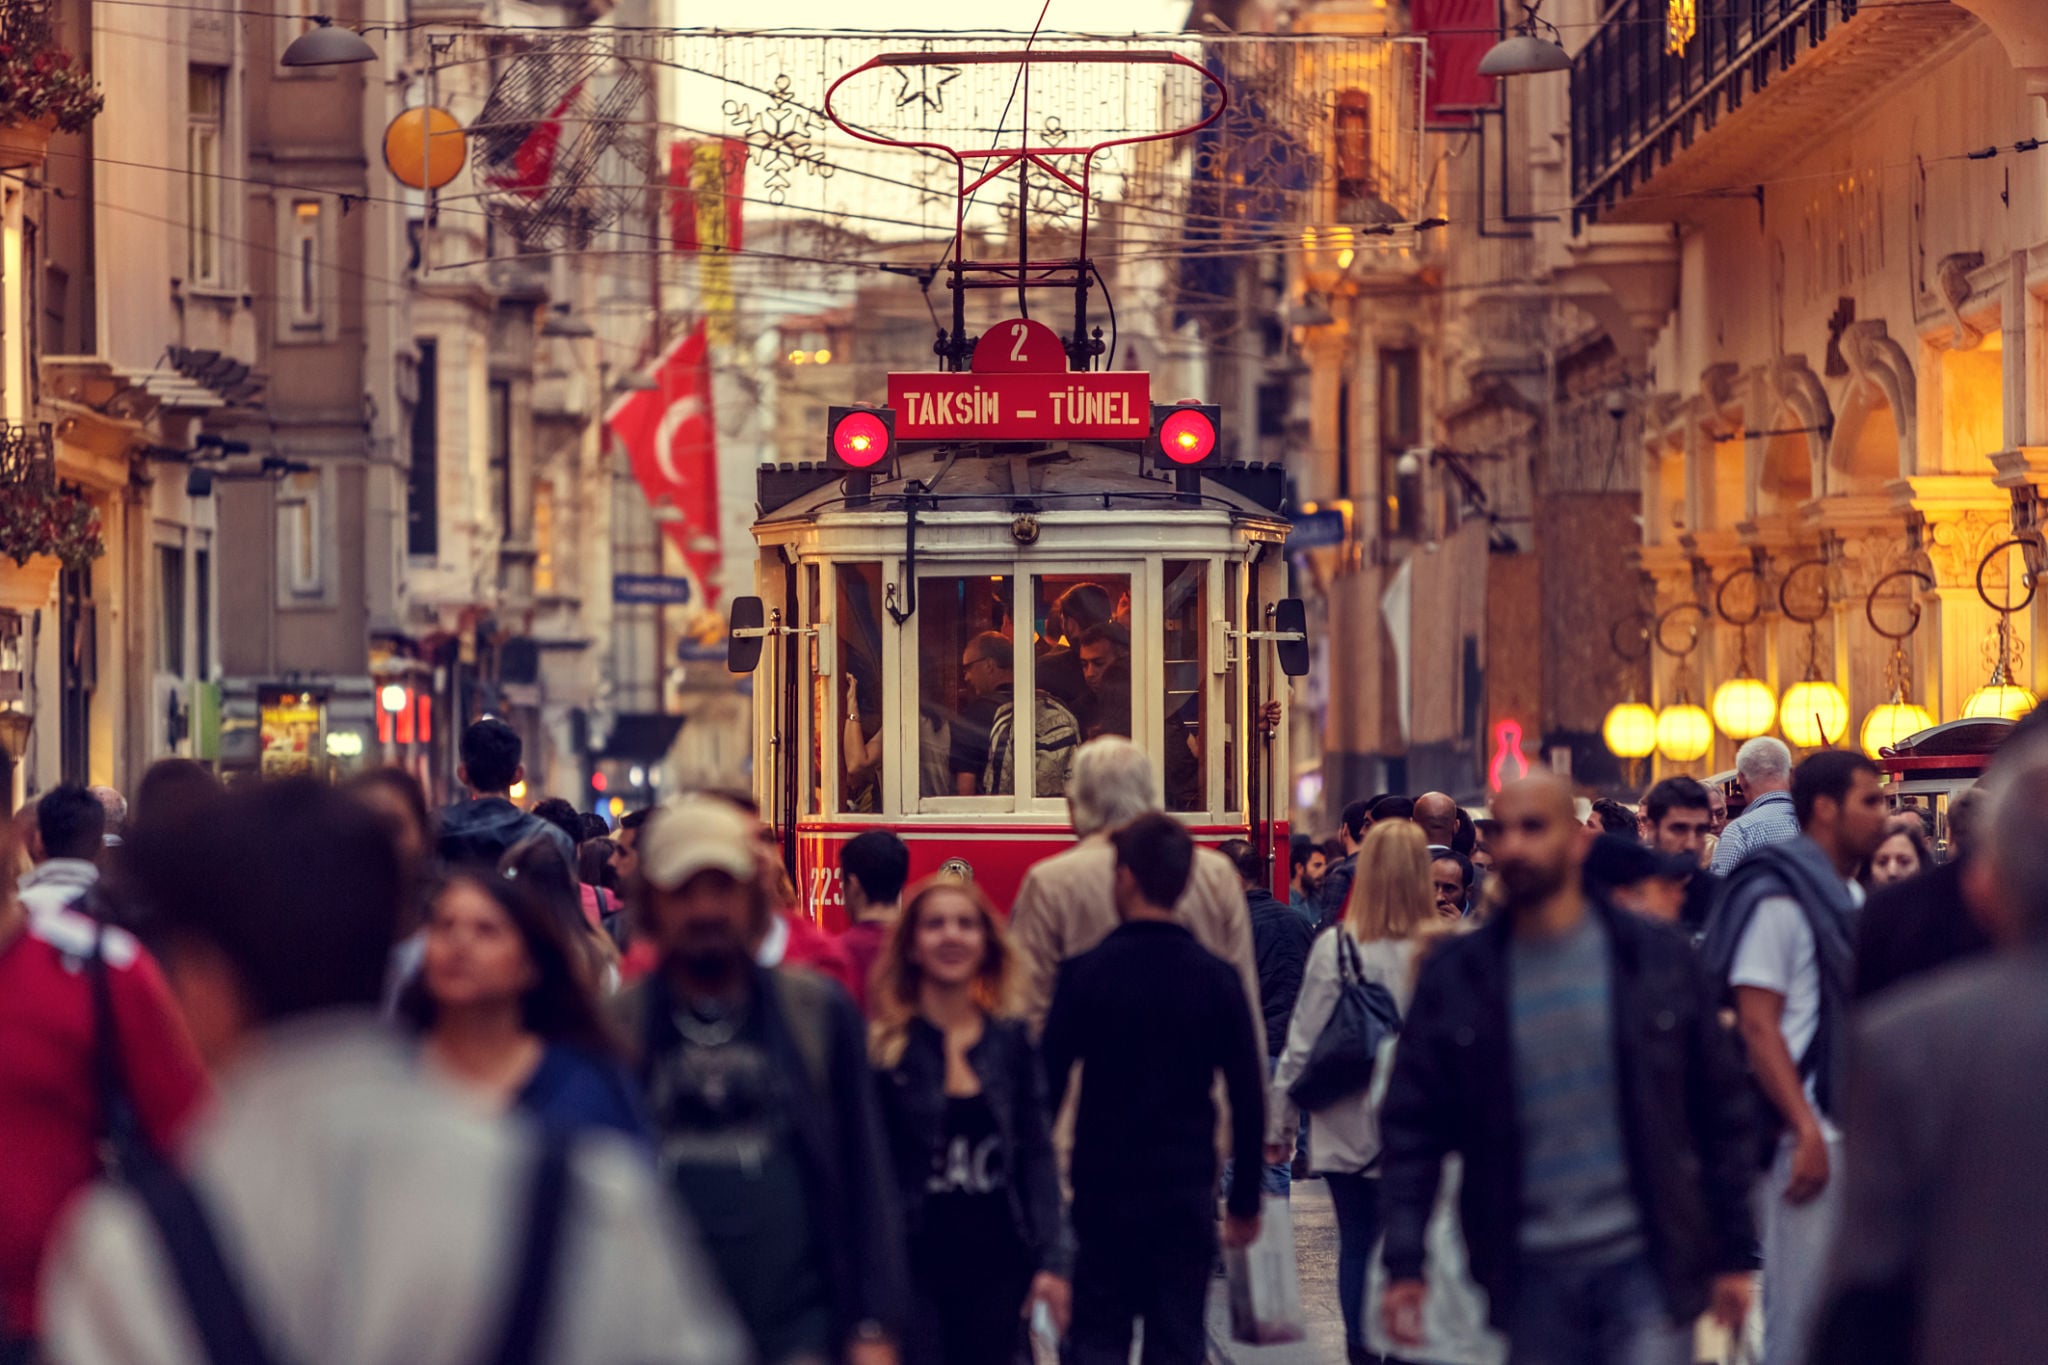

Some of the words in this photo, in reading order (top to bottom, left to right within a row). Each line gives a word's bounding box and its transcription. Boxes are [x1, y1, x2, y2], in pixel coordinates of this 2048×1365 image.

[1010, 324, 1028, 361] 2
[903, 385, 999, 425] TAKSİM
[1049, 385, 1139, 425] TÜNEL
